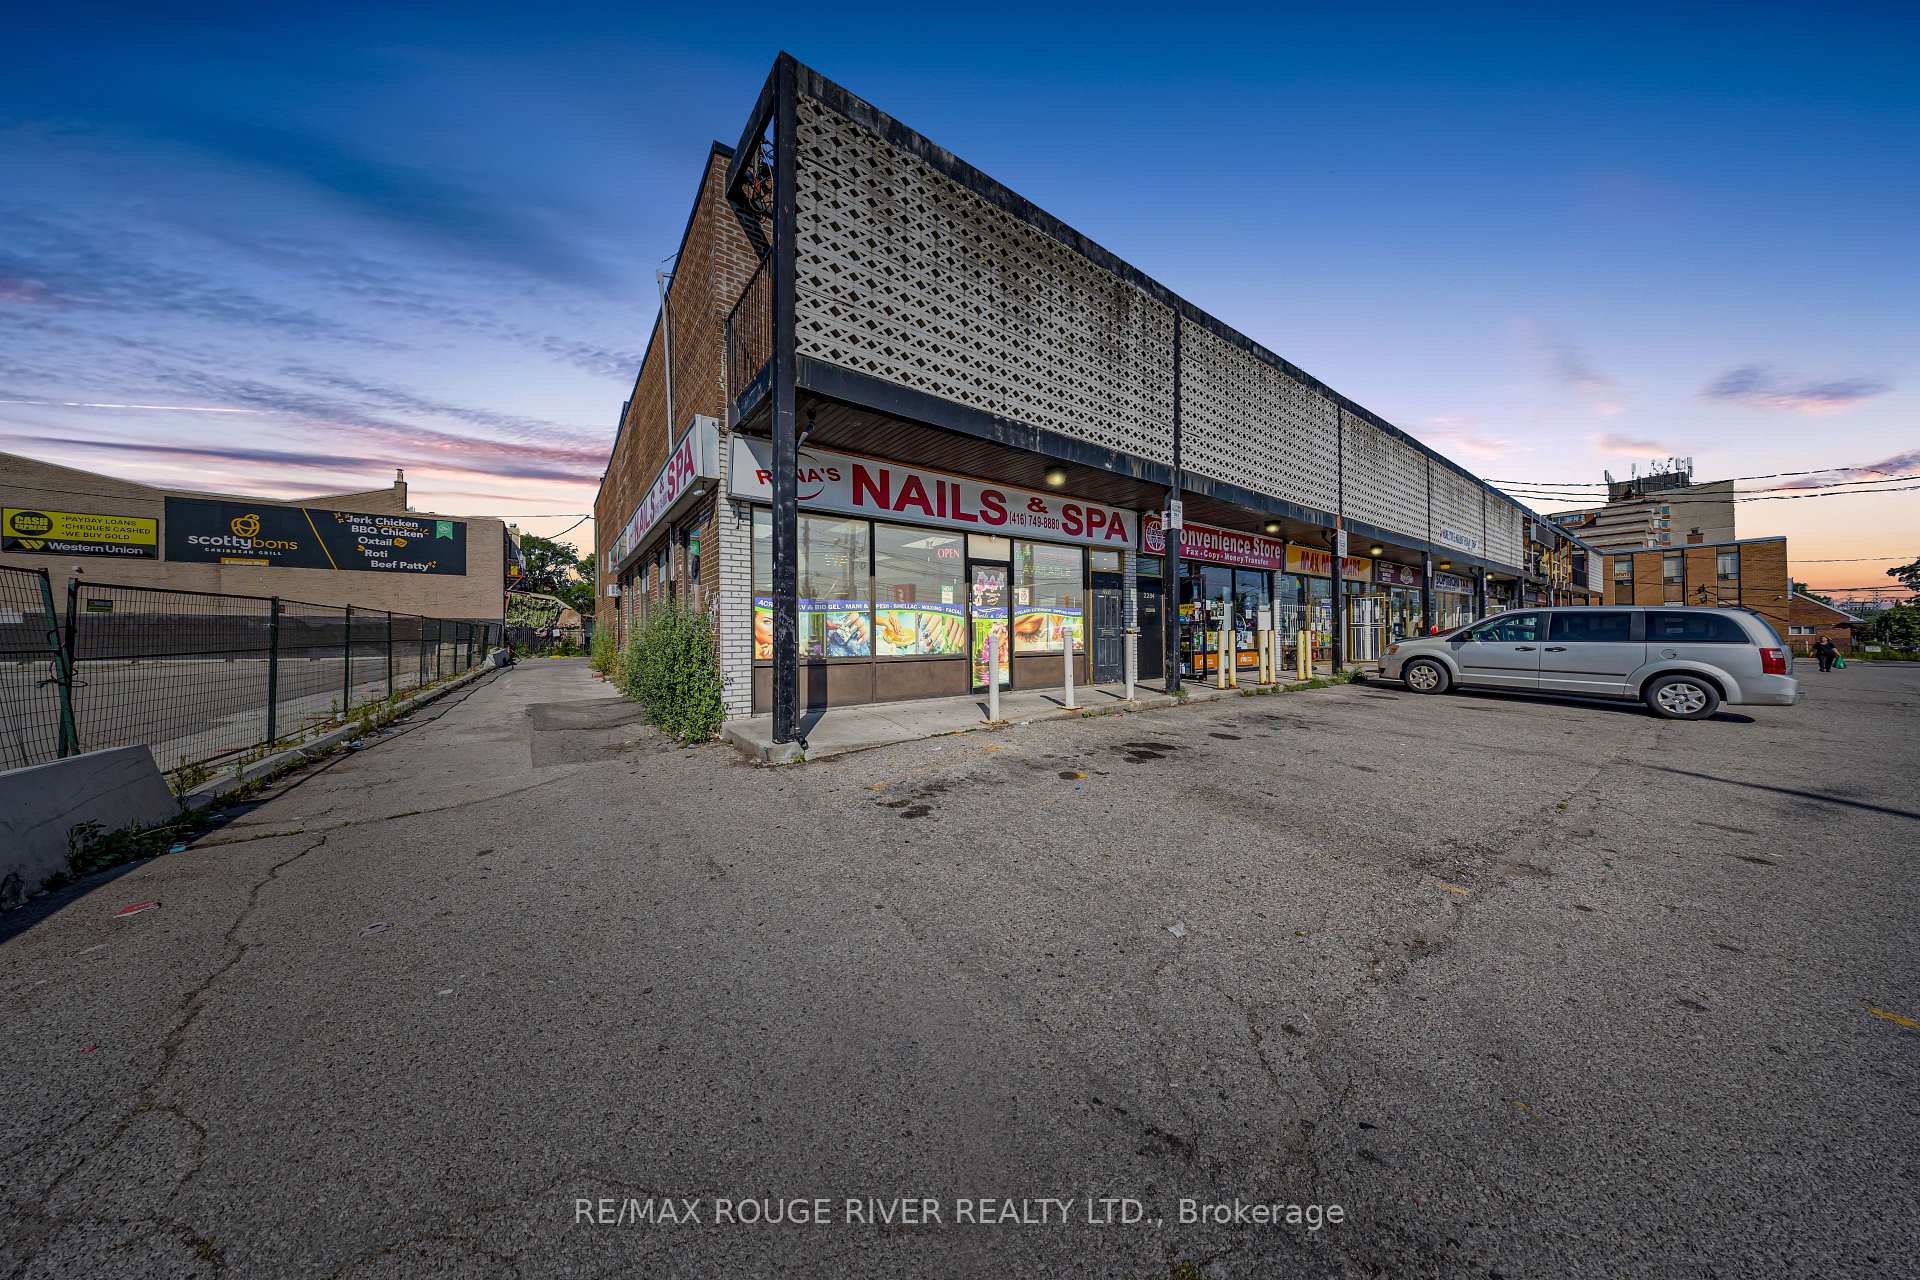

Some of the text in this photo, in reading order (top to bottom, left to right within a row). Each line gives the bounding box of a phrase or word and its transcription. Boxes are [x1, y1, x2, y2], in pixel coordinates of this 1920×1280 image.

[667, 435, 695, 502] SPA
[852, 463, 1007, 526] NAILS
[1027, 496, 1049, 514] &
[1061, 503, 1129, 543] SPA
[65, 516, 137, 526] PAYDAY LOANS
[346, 515, 419, 528] Jerk Chicken
[634, 490, 656, 544] NAILS
[1010, 511, 1060, 530] (416) 749-8880
[65, 524, 151, 535] CHEQUES CASHED
[351, 525, 424, 538] BBQ Chicken
[187, 535, 299, 550] scottybons
[358, 536, 393, 546] Oxtail
[1180, 528, 1251, 555] onvenience
[1253, 537, 1281, 559] Store
[48, 541, 144, 555] Western Union
[364, 549, 388, 558] Roti
[937, 548, 961, 559] OPEN
[1186, 547, 1199, 556] Fax
[1203, 550, 1220, 560] Copy
[1224, 552, 1244, 563] Money
[1300, 550, 1320, 572] MAX
[370, 560, 429, 571] Beef Patty
[945, 607, 962, 615] FACIAL
